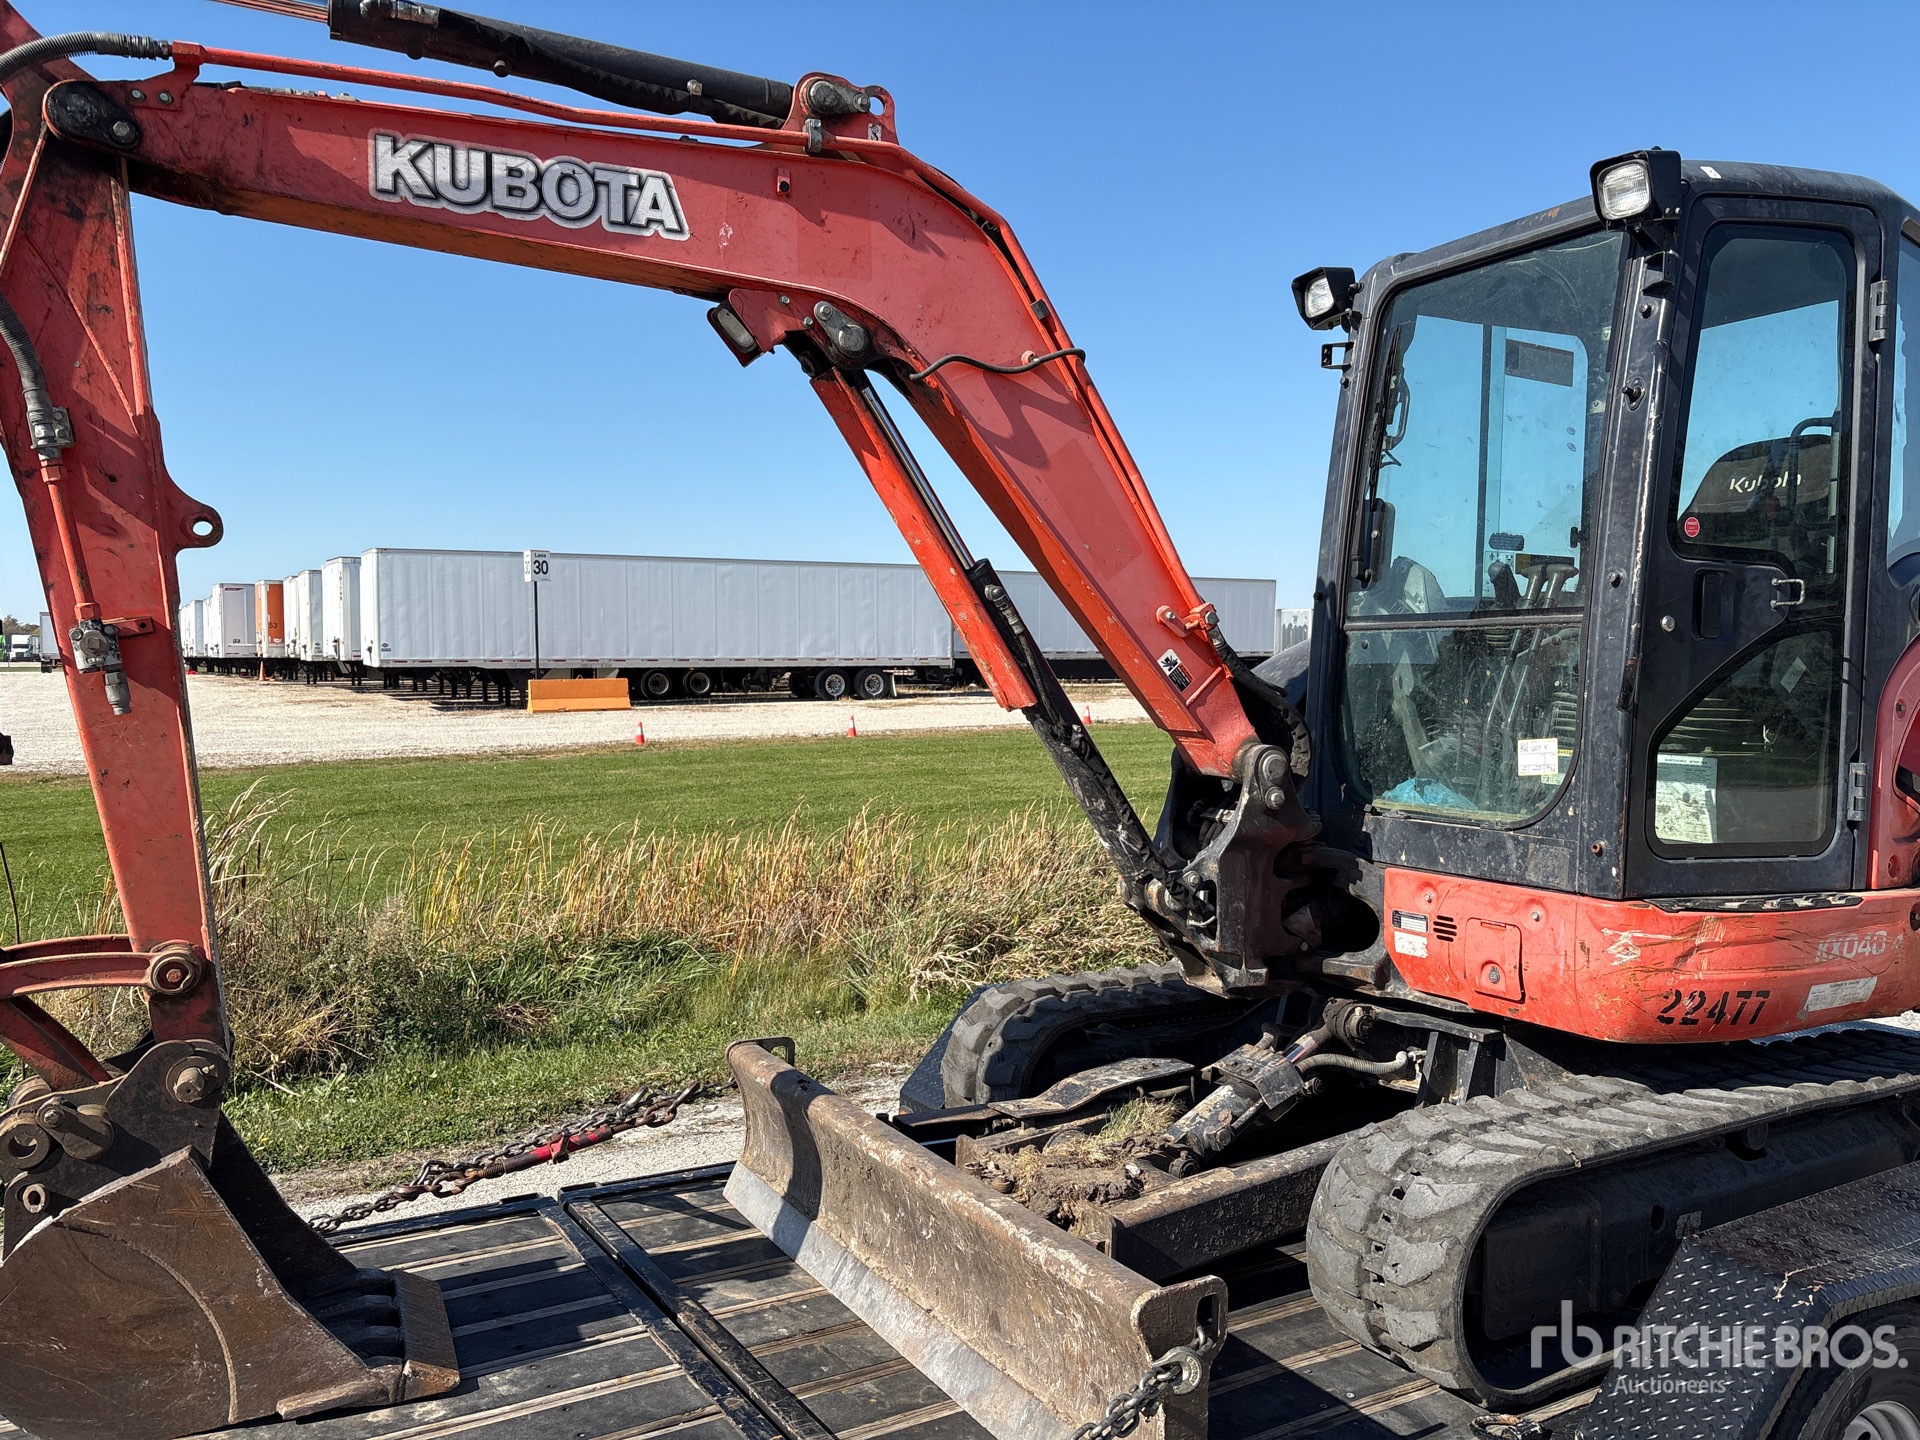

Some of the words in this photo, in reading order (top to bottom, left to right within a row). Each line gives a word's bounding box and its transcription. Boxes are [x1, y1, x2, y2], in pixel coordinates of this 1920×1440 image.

[372, 131, 688, 235] KUBOTA
[533, 559, 549, 575] 30
[1656, 989, 1771, 1026] 22477
